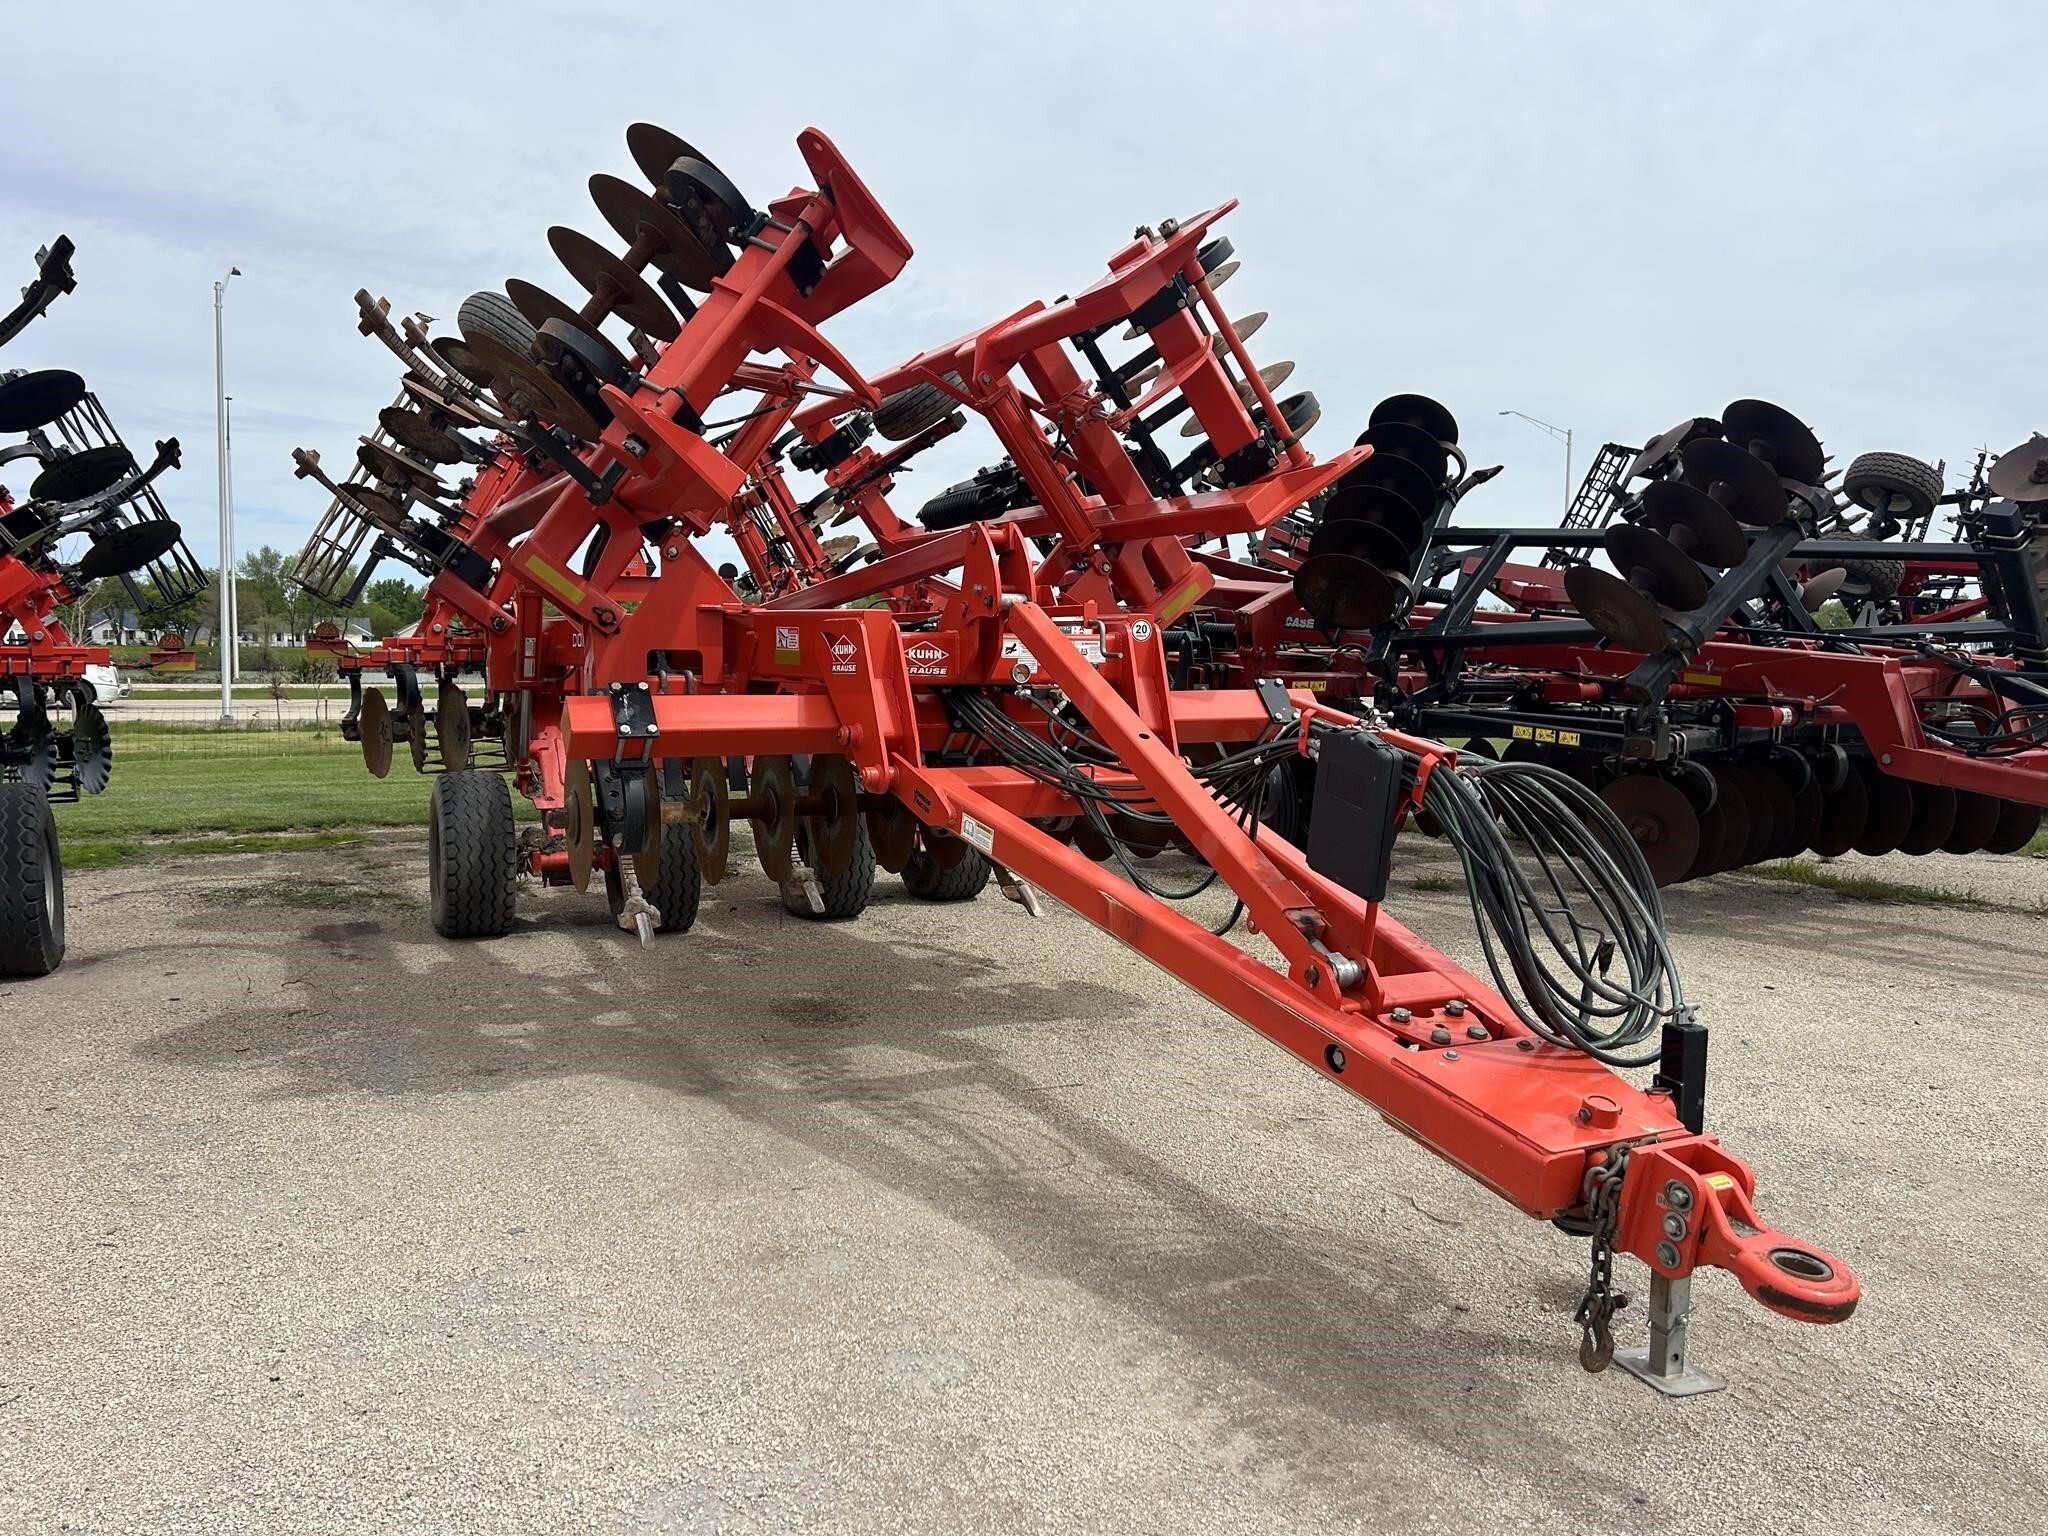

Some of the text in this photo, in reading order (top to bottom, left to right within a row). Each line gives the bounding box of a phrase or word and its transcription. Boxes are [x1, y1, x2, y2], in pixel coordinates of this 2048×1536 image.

[1286, 616, 1315, 629] CASE
[1135, 624, 1148, 634] 20
[835, 644, 854, 655] KUHN
[908, 649, 942, 659] KUHN
[832, 664, 857, 672] KRAUSE
